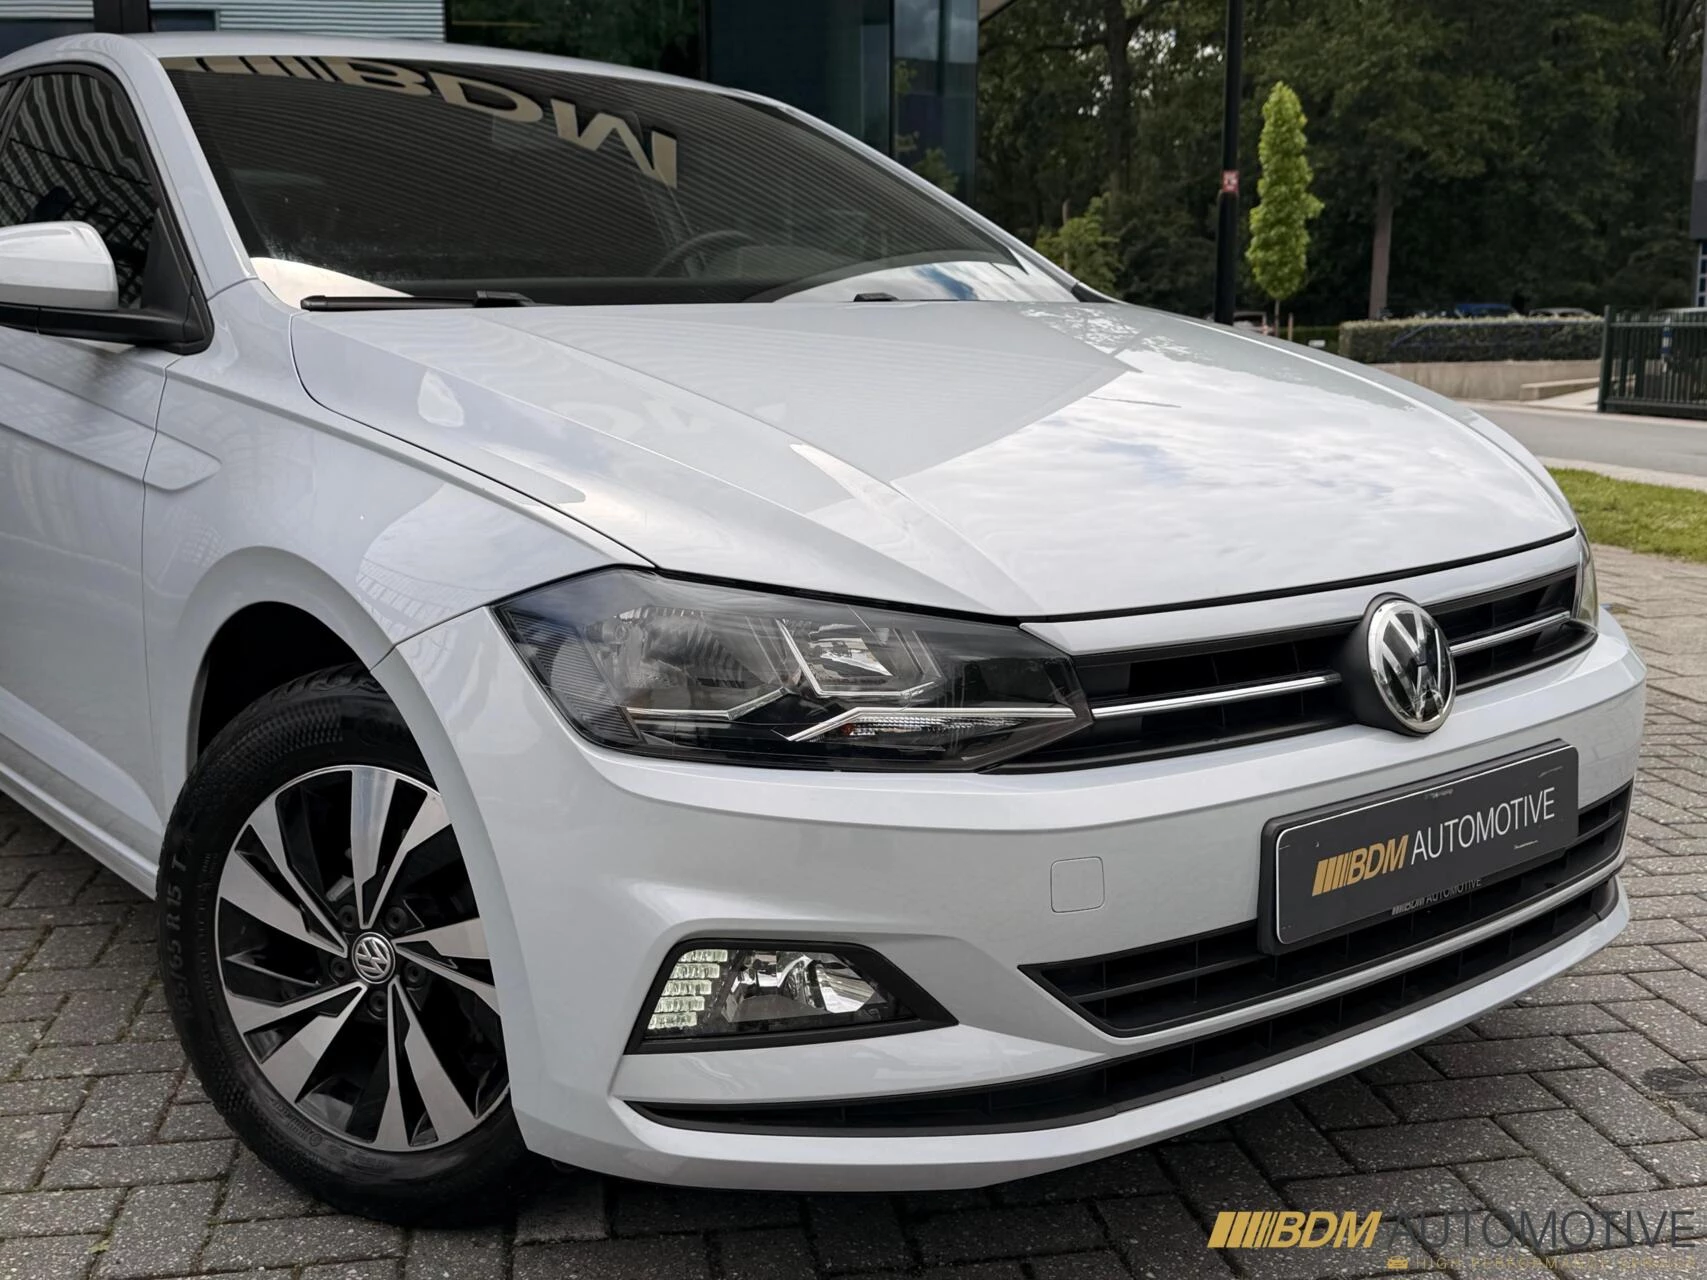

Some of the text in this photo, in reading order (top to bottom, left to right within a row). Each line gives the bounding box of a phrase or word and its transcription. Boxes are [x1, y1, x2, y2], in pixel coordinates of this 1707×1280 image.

[1347, 787, 1556, 884] BDM AUTOMOTIVE
[1426, 879, 1482, 904] AUTOMOTIVE
